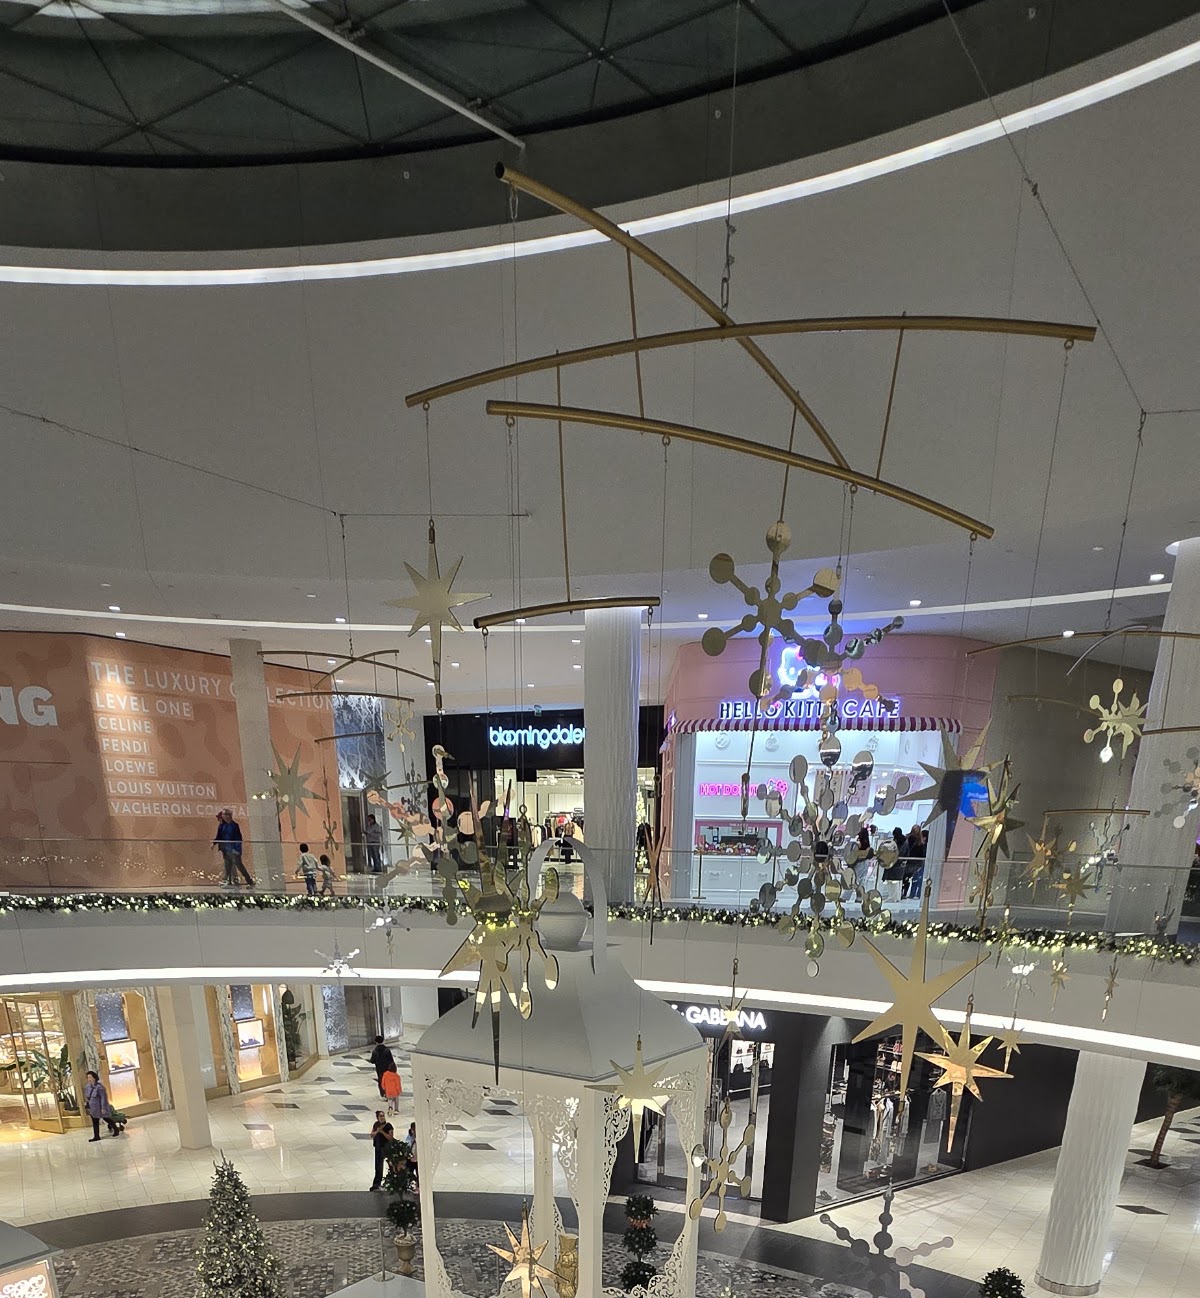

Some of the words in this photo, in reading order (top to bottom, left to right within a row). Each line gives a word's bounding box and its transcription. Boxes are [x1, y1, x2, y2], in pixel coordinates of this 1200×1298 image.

[90, 661, 135, 686] THE
[143, 668, 222, 697] LUXURY
[95, 691, 150, 714] LEVEL
[155, 698, 193, 718] ONE
[783, 699, 838, 720] KITT
[98, 716, 152, 734] CELINE
[102, 738, 148, 754] FENDI
[104, 759, 156, 774] LOEWE
[108, 781, 152, 796] LOUIS
[156, 783, 216, 798] VUITTON
[700, 783, 722, 797] HOT
[110, 801, 192, 816] VACHERON
